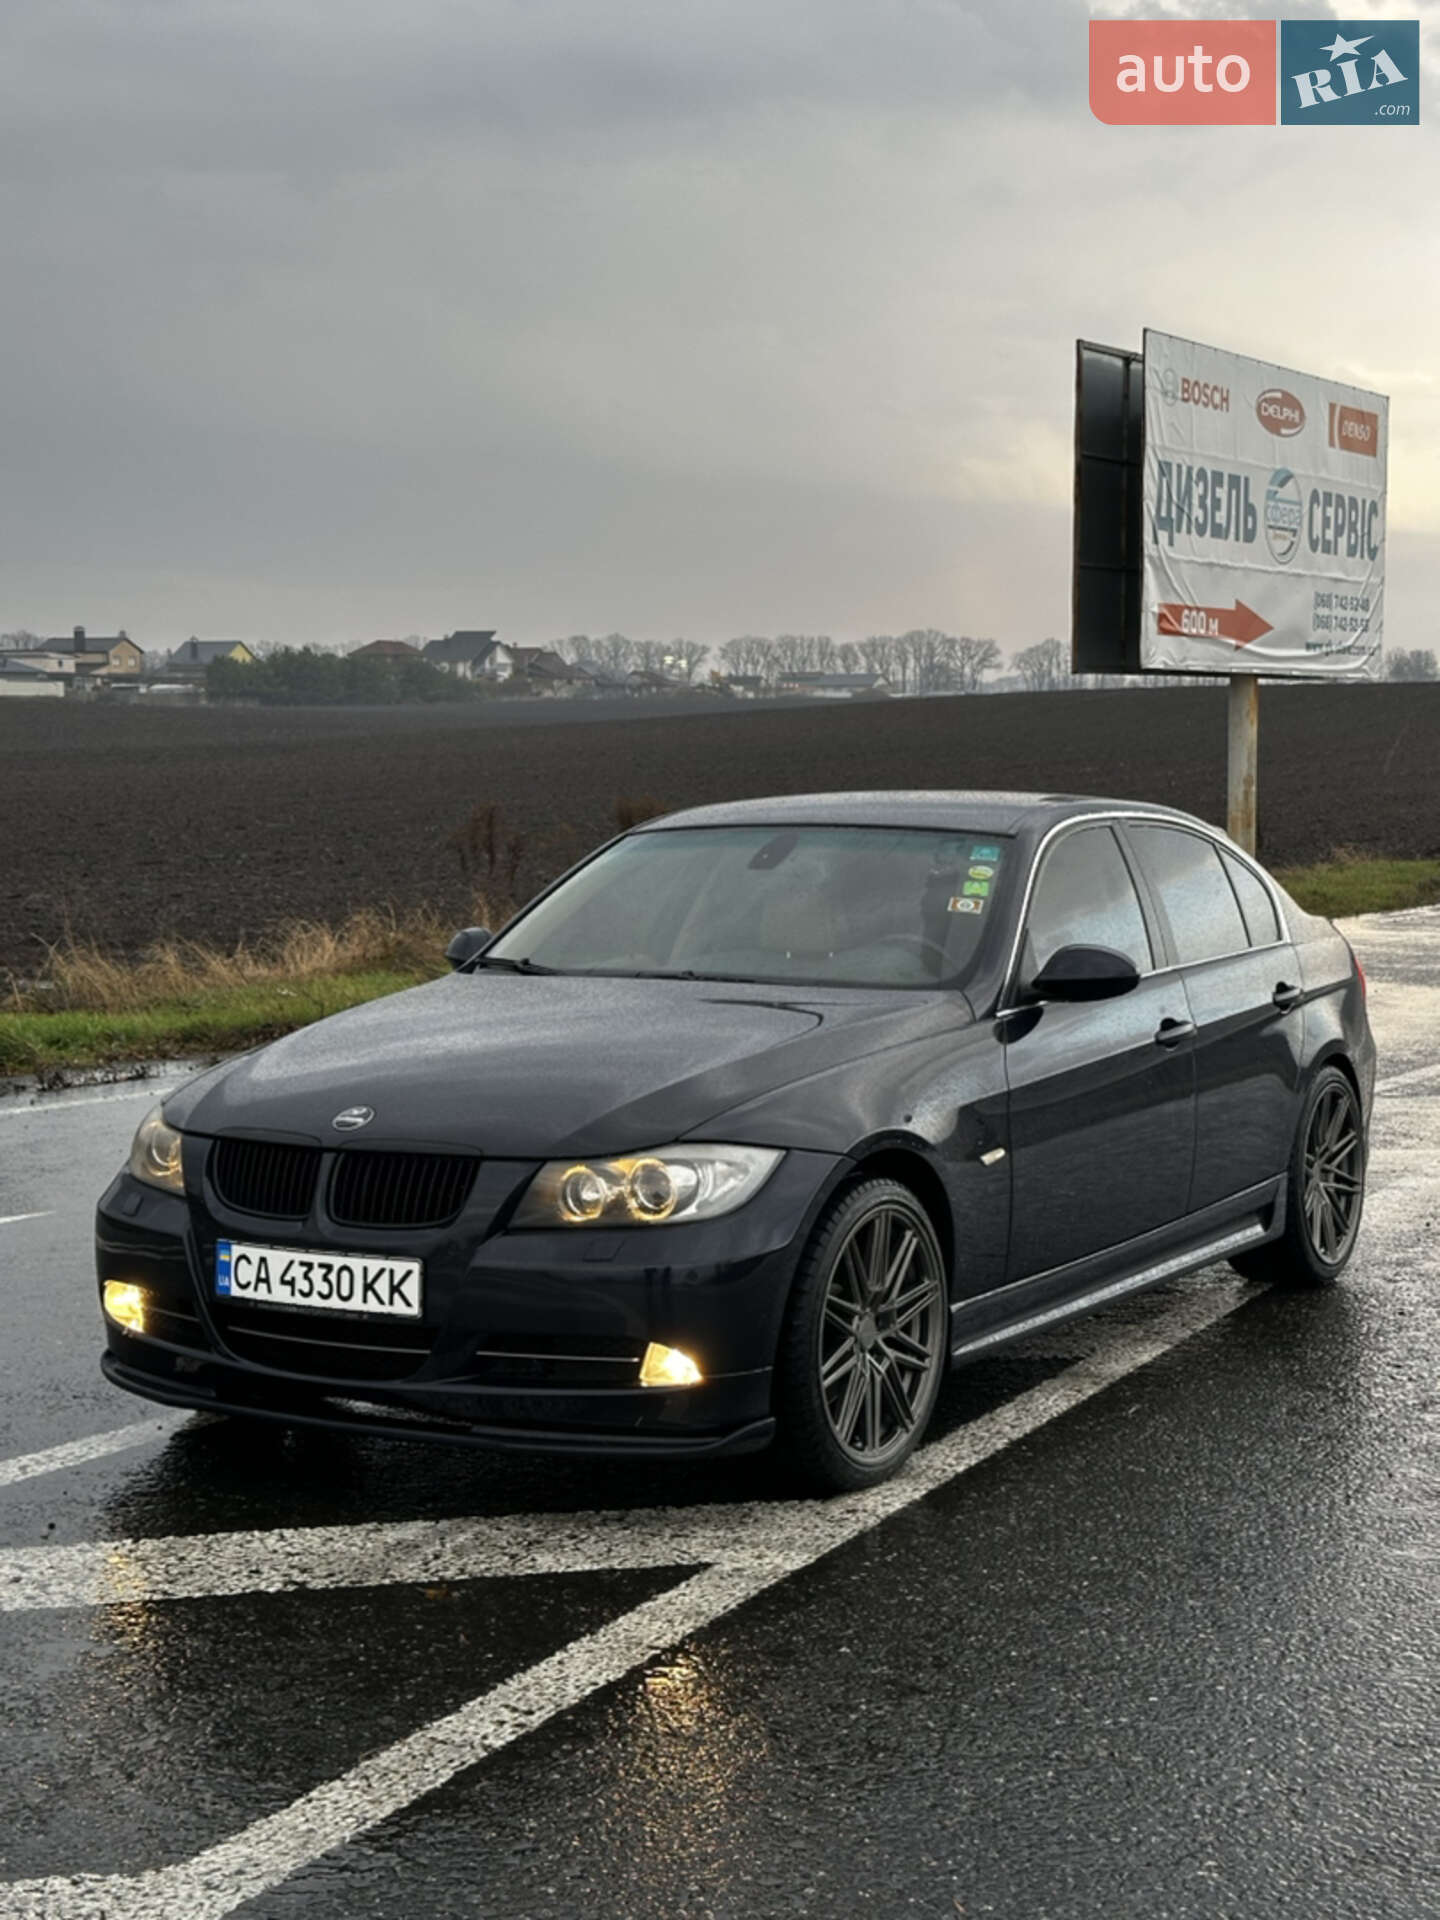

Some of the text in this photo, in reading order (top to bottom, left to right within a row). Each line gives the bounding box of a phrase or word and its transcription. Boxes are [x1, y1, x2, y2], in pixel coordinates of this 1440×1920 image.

[1180, 376, 1230, 413] BOSCH
[1260, 401, 1301, 424] DELPHI
[1341, 420, 1372, 442] DENSO
[1152, 459, 1380, 562] ДИЗЕЛЬ СЕРВІС
[1181, 607, 1207, 634] 600
[233, 1253, 414, 1309] CA 4330 KK
